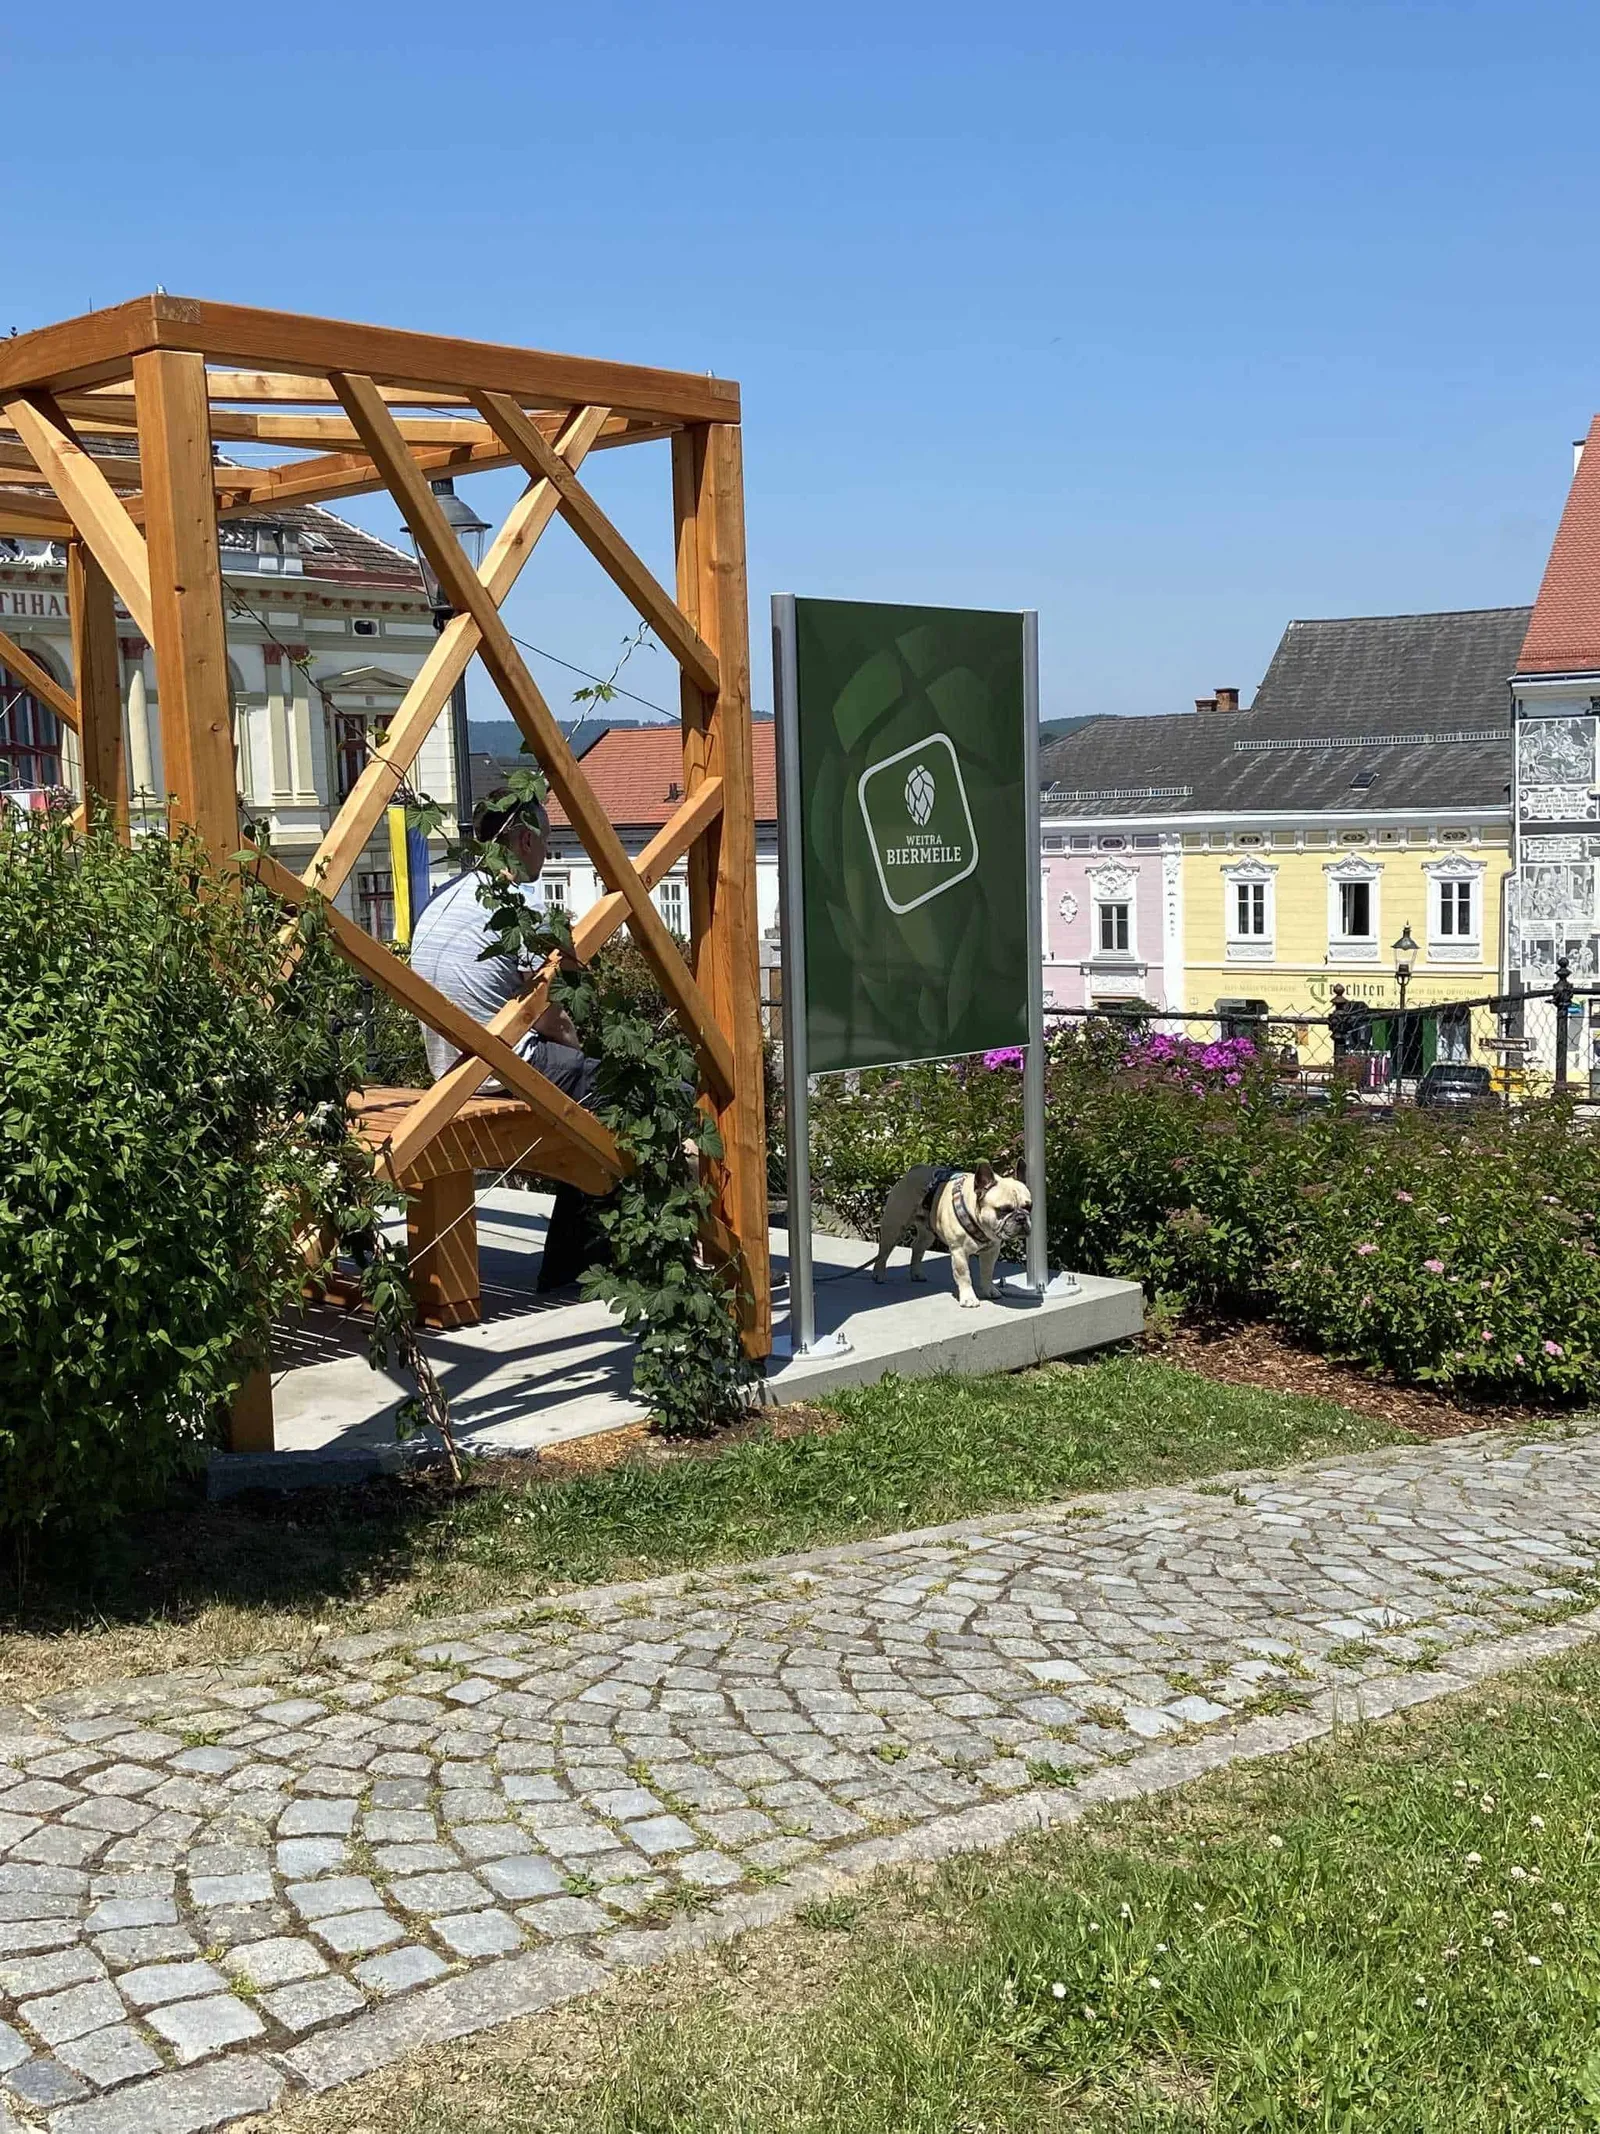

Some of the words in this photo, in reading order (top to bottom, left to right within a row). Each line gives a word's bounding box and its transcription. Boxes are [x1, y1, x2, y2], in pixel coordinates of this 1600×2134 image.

[0, 592, 71, 616] THHA
[906, 834, 942, 846] WEITRA
[886, 846, 962, 865] BIERMEILE
[1306, 976, 1385, 1004] Trchten
